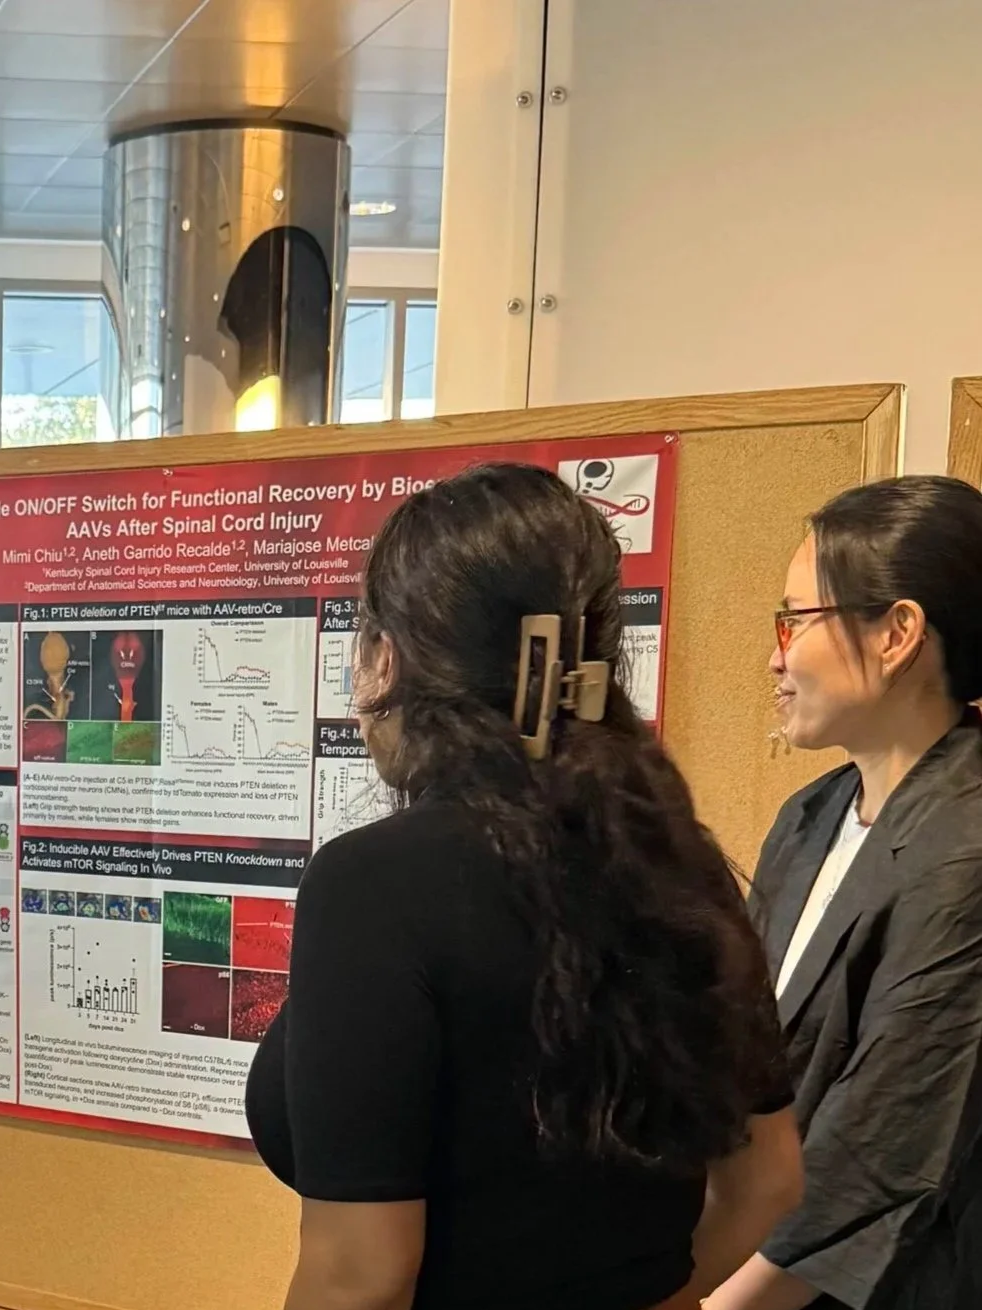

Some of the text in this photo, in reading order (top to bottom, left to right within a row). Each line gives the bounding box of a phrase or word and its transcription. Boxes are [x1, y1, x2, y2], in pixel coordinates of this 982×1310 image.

[14, 496, 77, 516] ON/OFF
[81, 492, 137, 513] Switch
[142, 491, 167, 509] for
[171, 485, 263, 508] Functional
[269, 481, 356, 503] Recovery
[361, 477, 385, 501] by
[391, 475, 436, 496] Bioe
[66, 511, 322, 539] AAVs After Spinal Cord Injury
[2, 550, 31, 564] Mimi
[83, 544, 120, 561] Aneth
[123, 543, 171, 559] Garrido
[254, 538, 322, 558] Mariajose
[326, 535, 375, 552] Metcal
[86, 566, 112, 578] Spinal
[114, 565, 136, 576] Cord
[137, 564, 161, 577] Injury
[163, 563, 206, 574] Research
[208, 562, 242, 574] Center,
[244, 560, 289, 573] University
[292, 559, 302, 570] of
[304, 558, 348, 570] Louisville
[77, 580, 86, 591] of
[87, 579, 135, 591] Anatomical
[137, 578, 177, 589] Sciences
[179, 578, 196, 588] and
[198, 576, 260, 589] Neurobiology,
[263, 574, 309, 588] University
[312, 574, 322, 584] of
[324, 572, 362, 584] Louisvil
[23, 608, 49, 619] Fig.1:
[51, 608, 78, 618] PTEN
[80, 606, 116, 617] deletion
[119, 606, 128, 616] of
[167, 605, 189, 615] mice
[191, 604, 212, 615] with
[213, 603, 282, 615] AAV-retro/Cre
[325, 601, 354, 615] Fig.3:
[323, 617, 360, 629] After S
[24, 632, 97, 641] A B
[320, 727, 350, 741] Fig.4:
[117, 776, 126, 784] C5
[213, 780, 238, 788] induces
[240, 781, 259, 789] PTEN
[262, 781, 288, 789] deletion
[163, 789, 171, 797] by
[203, 791, 239, 799] expression
[255, 792, 268, 800] loss
[269, 792, 277, 800] of
[278, 792, 298, 800] PTEN
[54, 804, 78, 812] strength
[79, 805, 99, 813] testing
[136, 807, 154, 815] PTEN
[246, 813, 276, 821] recovery,
[278, 813, 299, 821] driven
[23, 841, 304, 869] Fig.2: Inducible AAV Effectively Drives PTEN Knockdown and
[22, 856, 172, 875] Activates mTOR Signaling In Vivo
[46, 1073, 68, 1082] Cortical
[166, 1070, 185, 1079] stable
[186, 1074, 220, 1083] expression
